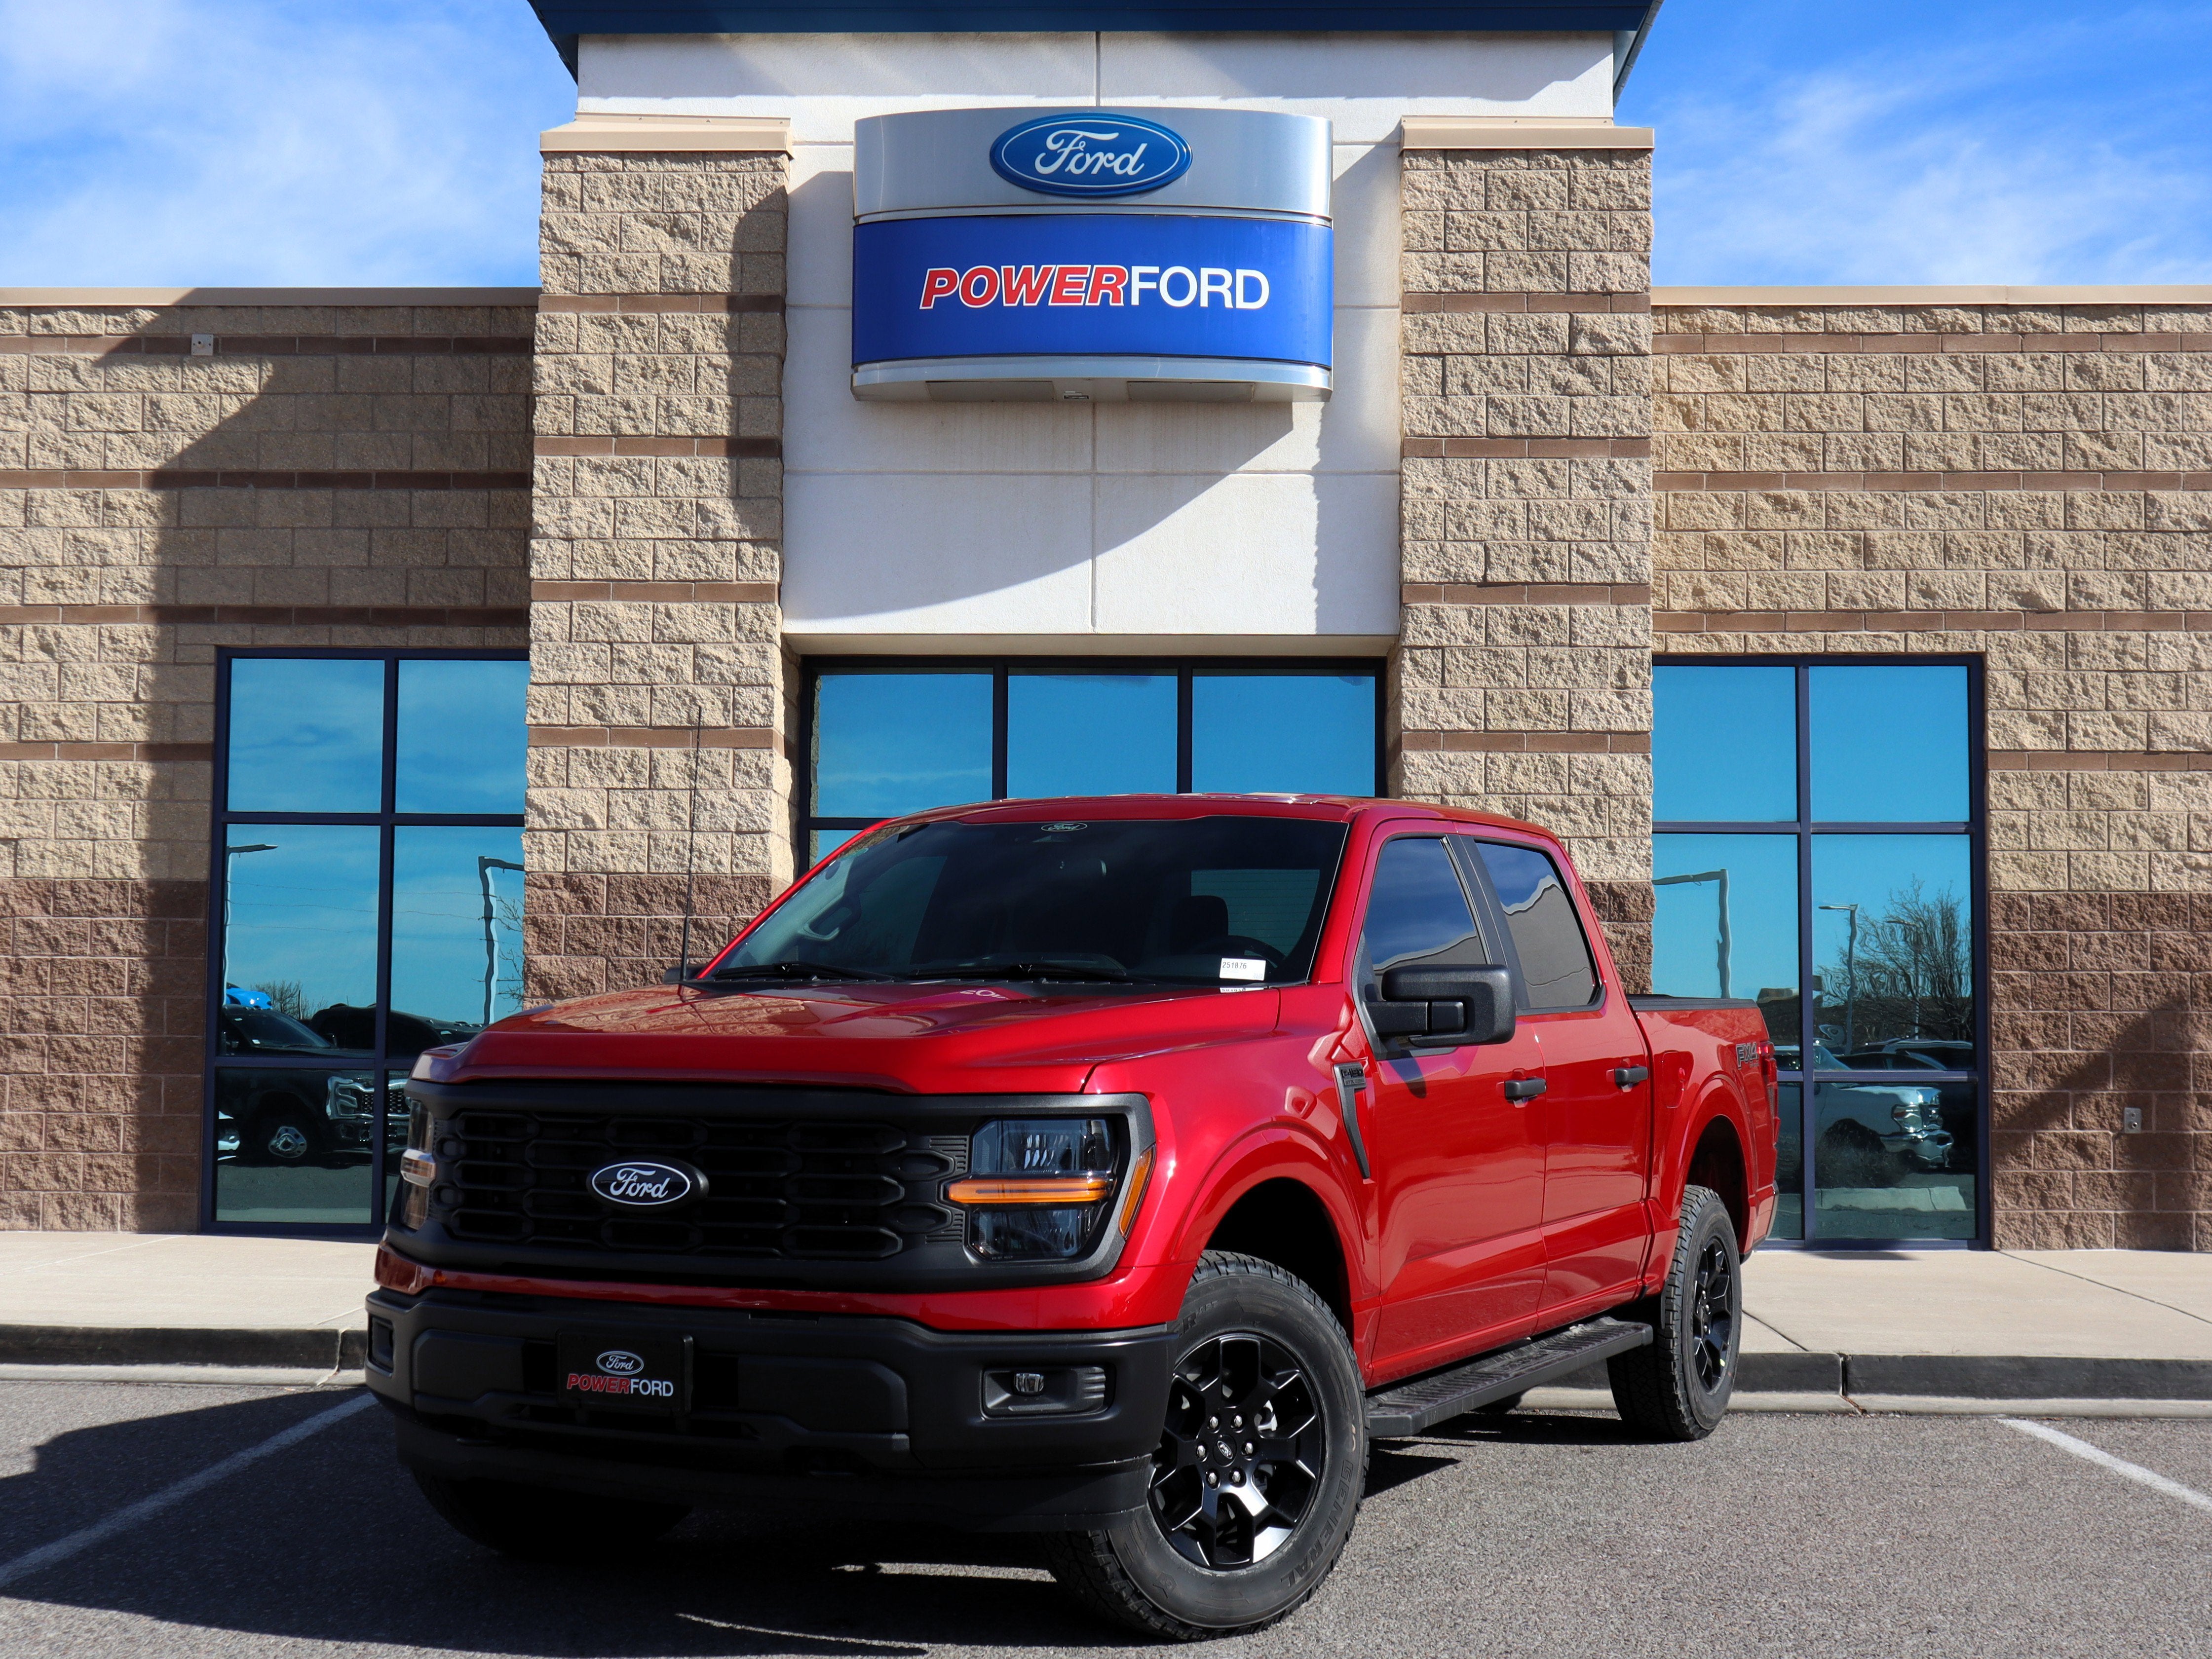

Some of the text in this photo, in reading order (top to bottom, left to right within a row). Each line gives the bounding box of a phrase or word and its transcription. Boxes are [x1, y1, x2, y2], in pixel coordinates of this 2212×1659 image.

[1034, 129, 1147, 176] Ford
[919, 265, 1270, 310] POWERFORD
[1735, 1042, 1759, 1070] FX4
[609, 1167, 671, 1199] Ford
[606, 1355, 634, 1370] Ford
[567, 1373, 674, 1397] POWERFORD
[1280, 1459, 1354, 1587] GENERAL
